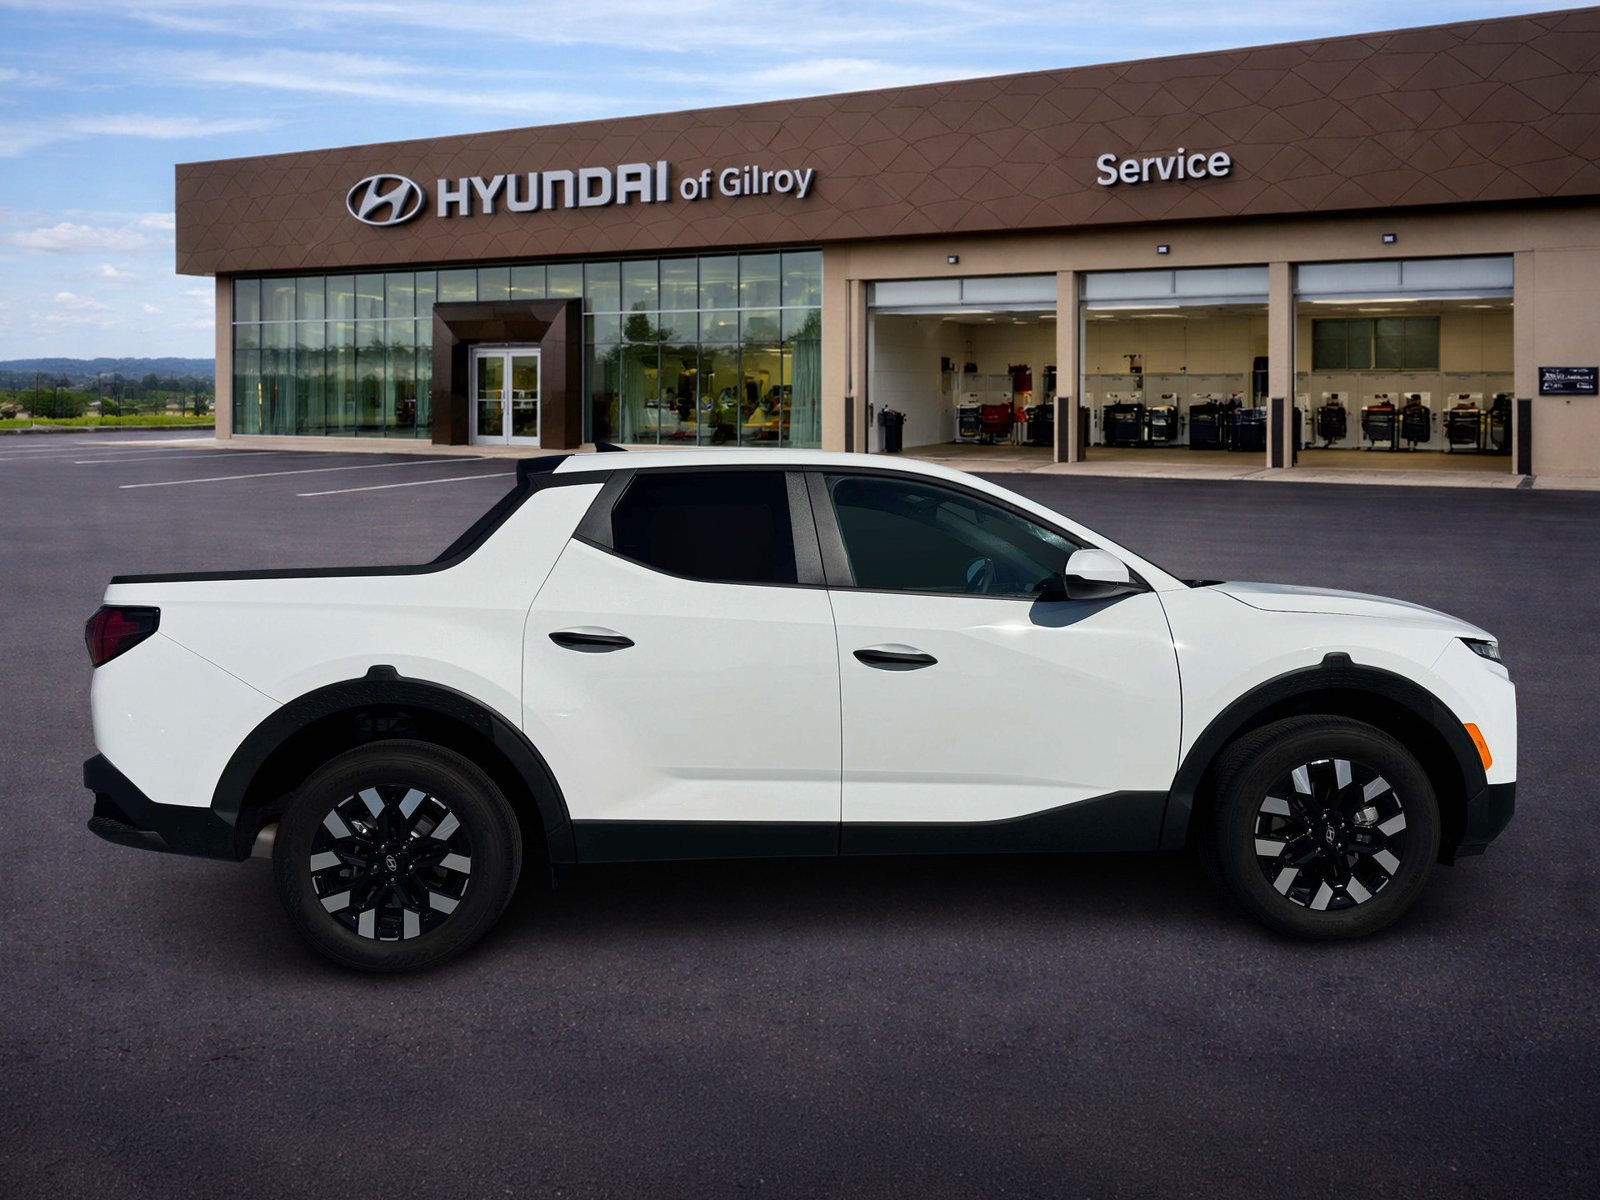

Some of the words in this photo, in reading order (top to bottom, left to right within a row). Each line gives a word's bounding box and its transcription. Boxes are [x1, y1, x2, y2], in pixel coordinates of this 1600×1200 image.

[436, 160, 670, 218] HYUNDAI
[679, 166, 711, 201] of
[718, 163, 814, 199] Gilroy
[1096, 147, 1232, 186] Service
